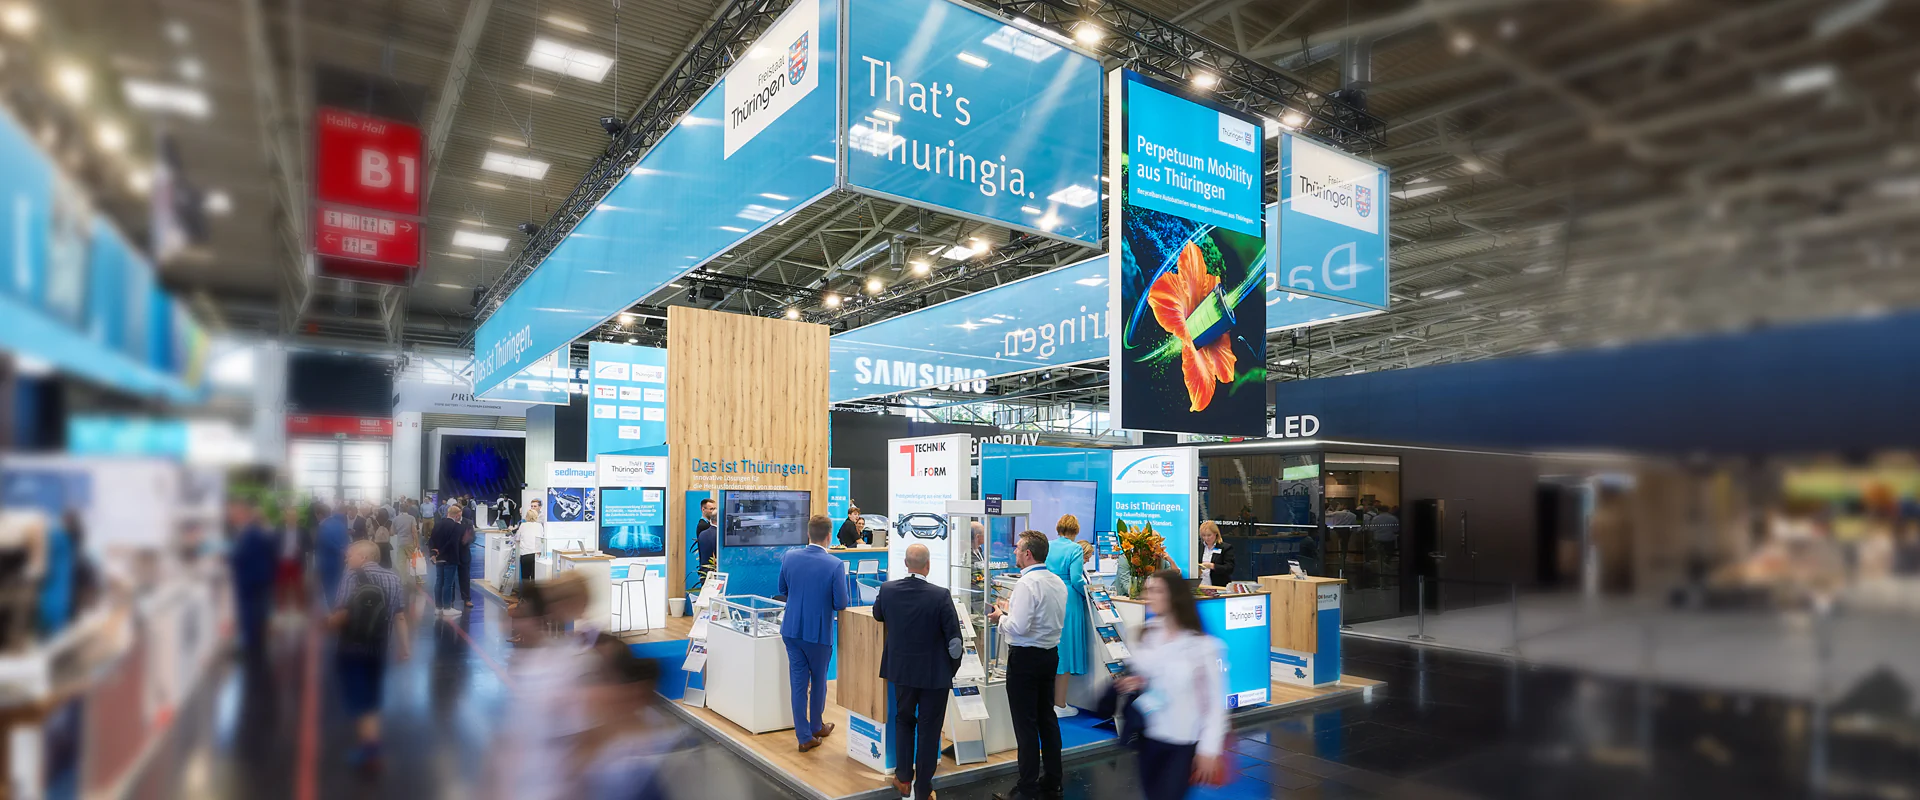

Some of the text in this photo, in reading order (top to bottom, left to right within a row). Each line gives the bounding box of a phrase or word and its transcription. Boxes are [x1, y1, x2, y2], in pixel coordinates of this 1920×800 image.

[758, 55, 785, 86] Freistaat
[731, 73, 785, 129] Thüringen
[326, 114, 387, 136] Halle Hall
[1222, 128, 1244, 141] Thüringen
[864, 115, 1035, 200] Thuringia.
[1137, 134, 1253, 190] Perpetuum Mobility
[360, 148, 415, 194] B1
[1137, 163, 1225, 200] aus Thüringen
[1300, 175, 1353, 208] Thüringen
[476, 324, 533, 384] Das ist Thüringen.
[855, 357, 987, 394] SAMSUNG
[1266, 415, 1320, 438] LED
[555, 468, 596, 478] sedlmayer
[612, 465, 642, 474] Thüringen
[692, 458, 809, 477] Das ist Thüringen.
[924, 467, 946, 477] FORM
[724, 475, 750, 484] Lösungen
[1116, 501, 1184, 513] Das ist Thüringen.
[1229, 611, 1255, 621] Thüringen
